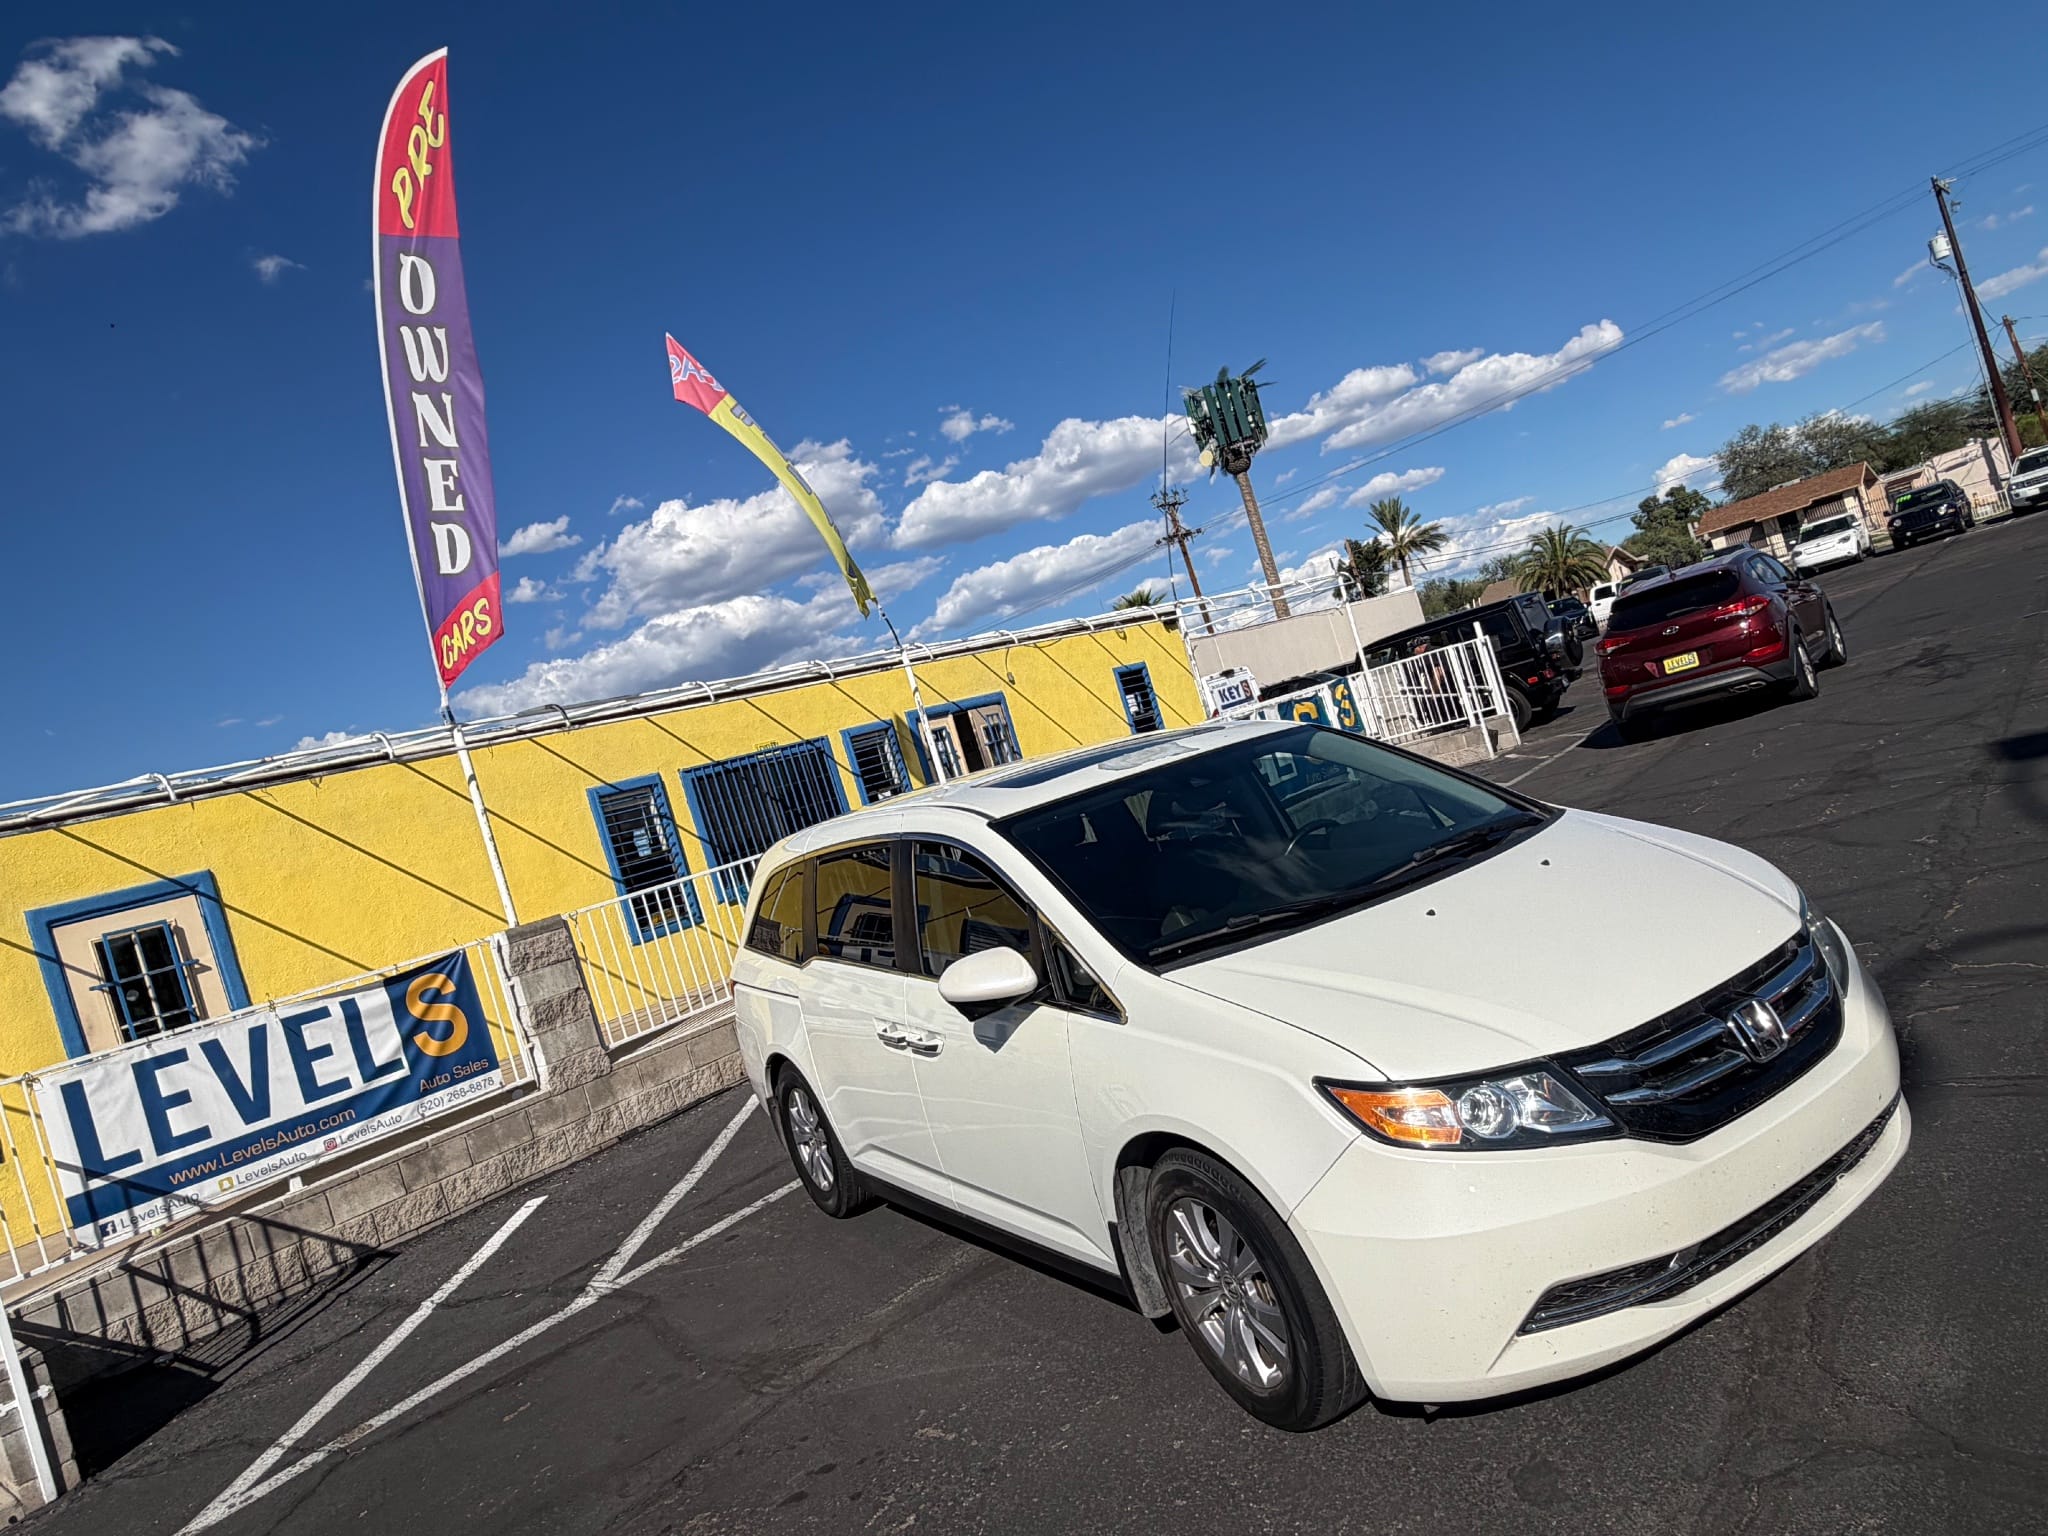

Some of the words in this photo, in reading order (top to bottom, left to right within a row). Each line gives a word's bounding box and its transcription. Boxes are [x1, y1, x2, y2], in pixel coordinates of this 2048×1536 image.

[391, 80, 445, 229] PRE
[399, 252, 472, 575] OWNED
[441, 597, 492, 670] CARS
[1218, 680, 1252, 703] KEYS
[60, 972, 470, 1181] LEVELS
[416, 1093, 445, 1116] (520)
[446, 1076, 495, 1103] 268-8878
[419, 1072, 451, 1093] Auto
[453, 1058, 489, 1080] Sales
[168, 1107, 357, 1185] www.LevelsAuto.com
[338, 1113, 403, 1146] LevelsAuto
[234, 1149, 309, 1186] LevelsAuto
[118, 1190, 201, 1231] LevelsAuto
